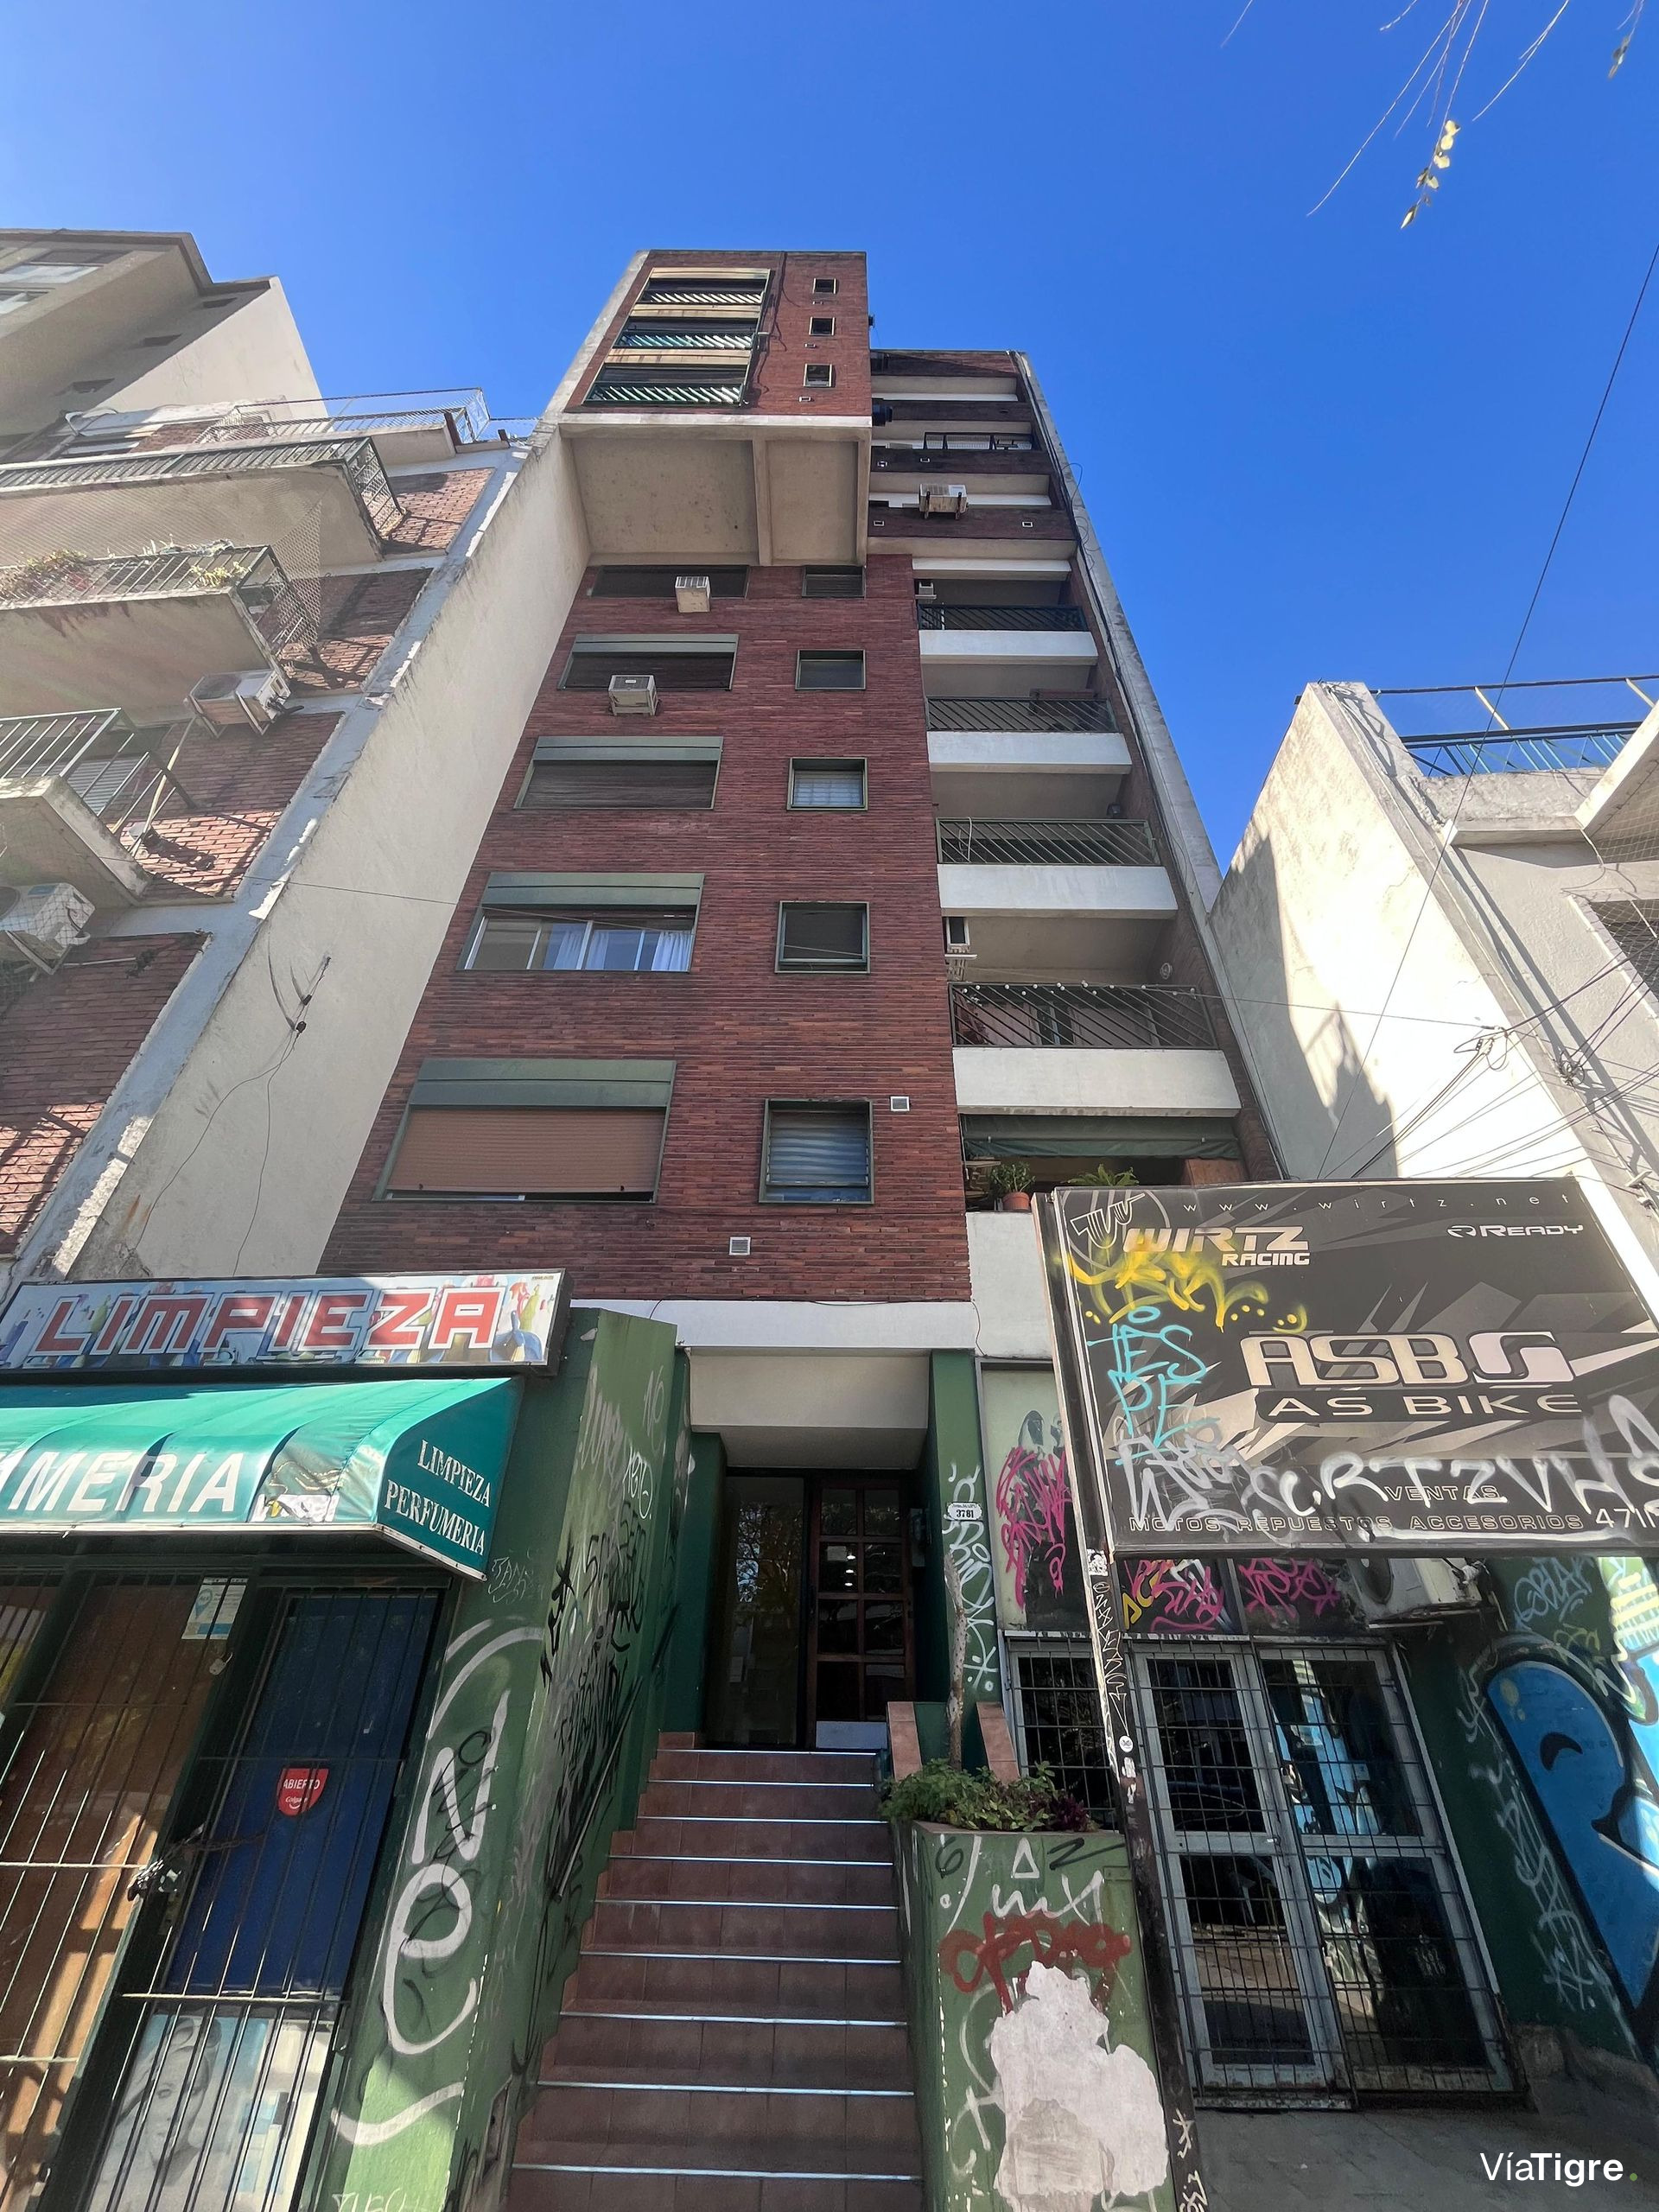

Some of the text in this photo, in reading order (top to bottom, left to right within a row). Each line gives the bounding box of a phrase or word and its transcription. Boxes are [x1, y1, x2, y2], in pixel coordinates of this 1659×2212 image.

[1123, 1226, 1310, 1252] WIRTZ
[1480, 1224, 1584, 1237] READY
[1221, 1252, 1310, 1267] RACING
[33, 1287, 503, 1356] LIMPIEZA
[1268, 1394, 1582, 1417] AS BIKE
[0, 1448, 245, 1513] MERIA
[417, 1440, 491, 1508] LIMPIEZA
[1384, 1484, 1499, 1502] VENTAS
[384, 1479, 485, 1555] PERFUMERIA
[956, 1509, 974, 1518] 3781
[1128, 1516, 1220, 1532] MOTOS
[1237, 1515, 1392, 1532] REPUESTOS
[1410, 1514, 1584, 1530] ACCESORIOS
